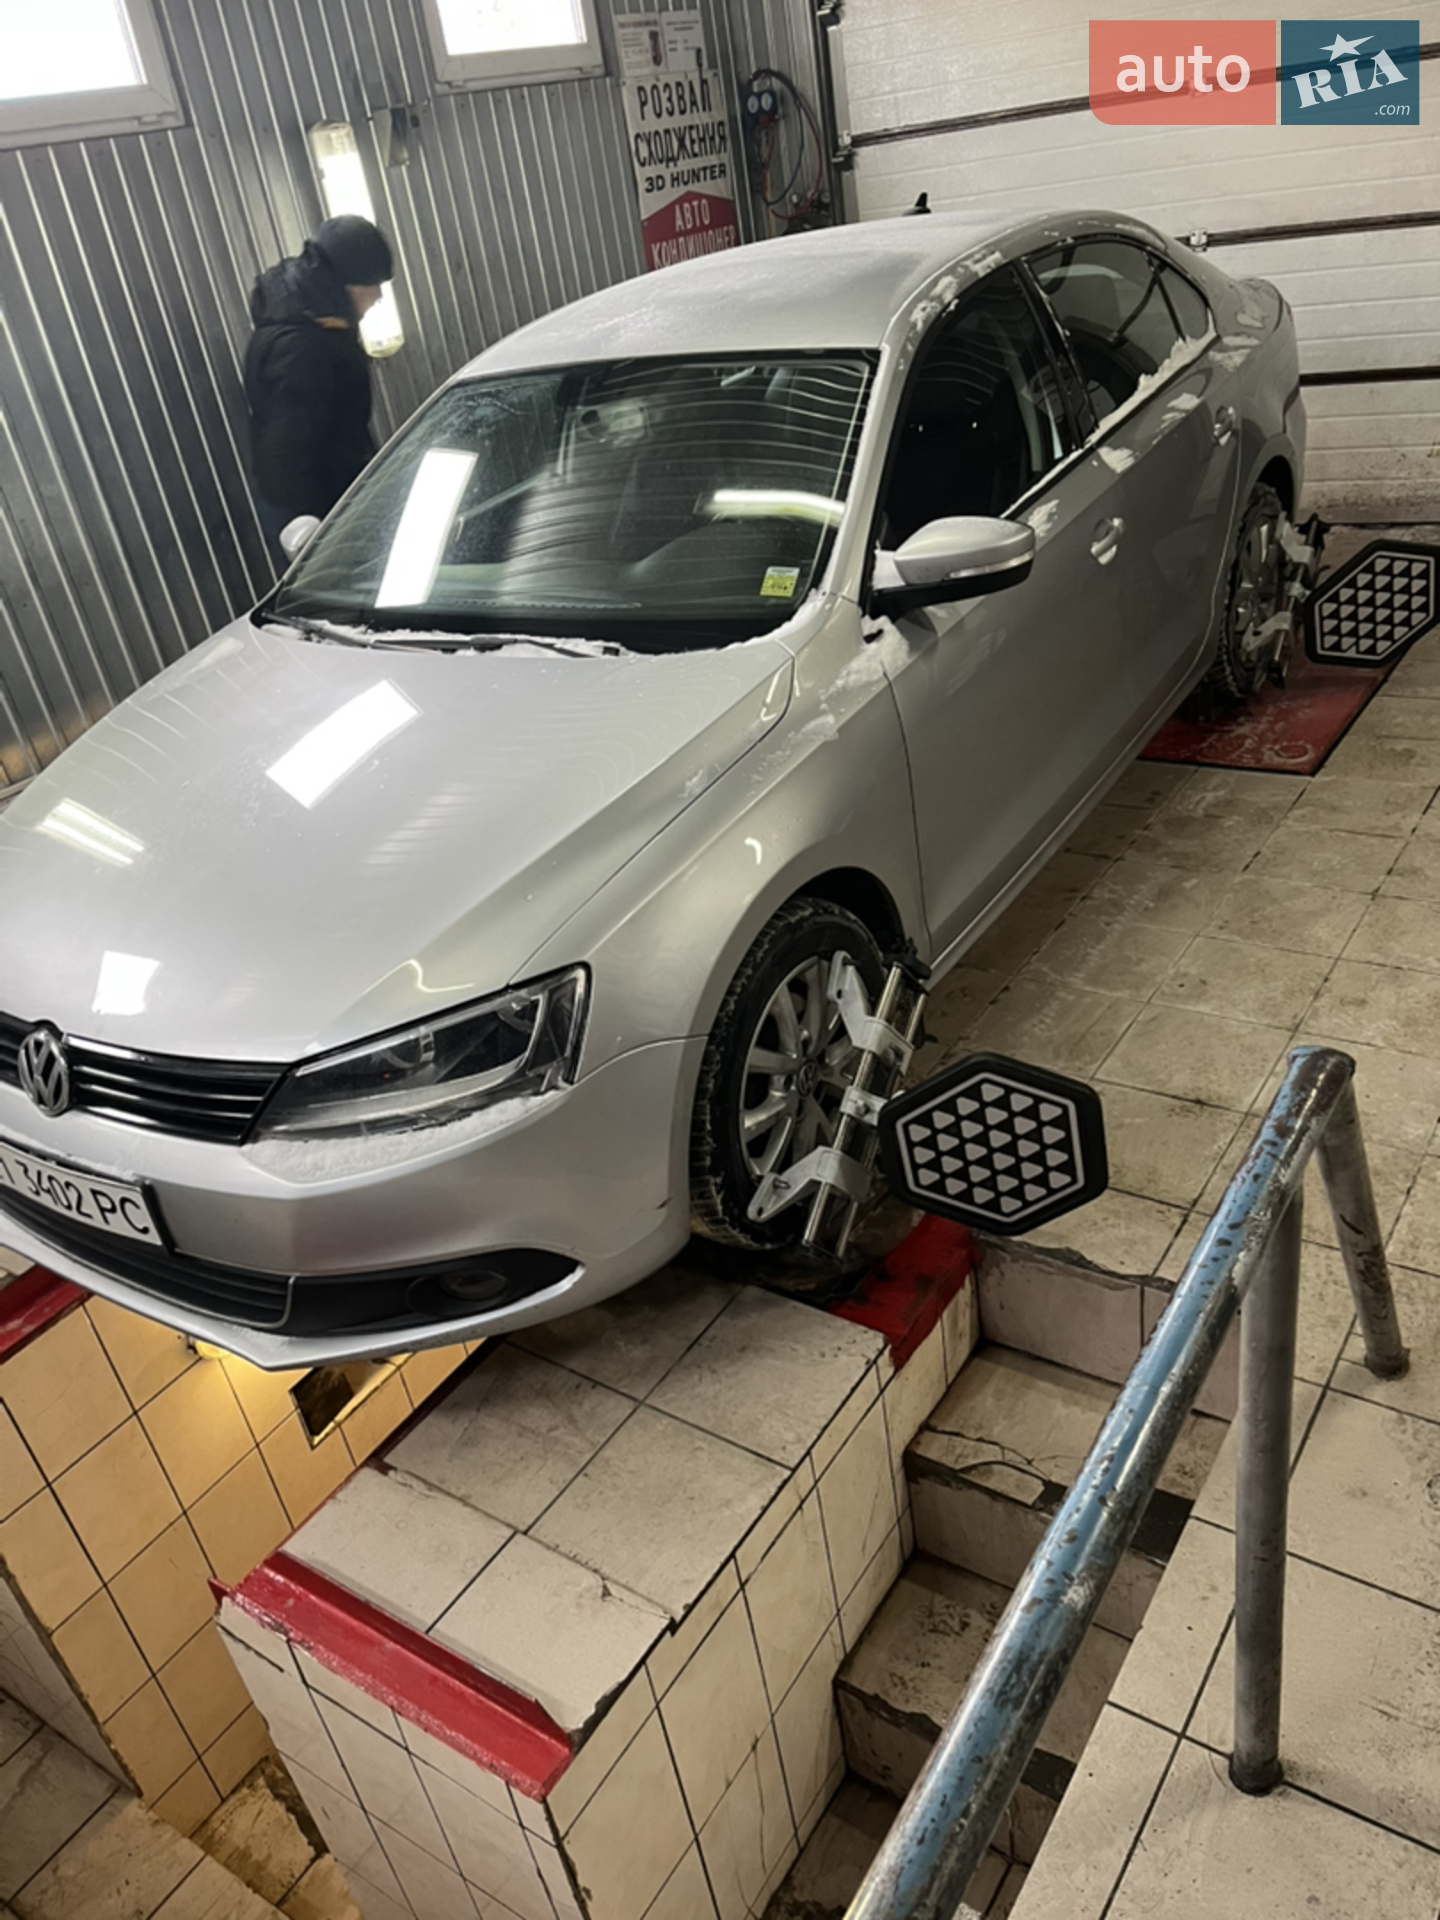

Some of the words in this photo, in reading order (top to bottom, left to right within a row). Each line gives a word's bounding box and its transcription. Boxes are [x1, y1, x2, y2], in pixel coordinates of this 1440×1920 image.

[634, 121, 727, 169] СХОДЖЕННЯ
[645, 174, 666, 193] 3D
[670, 163, 727, 188] HUNTER
[674, 198, 710, 232] АВТО
[15, 1159, 93, 1220] 3402
[90, 1187, 149, 1235] PC
